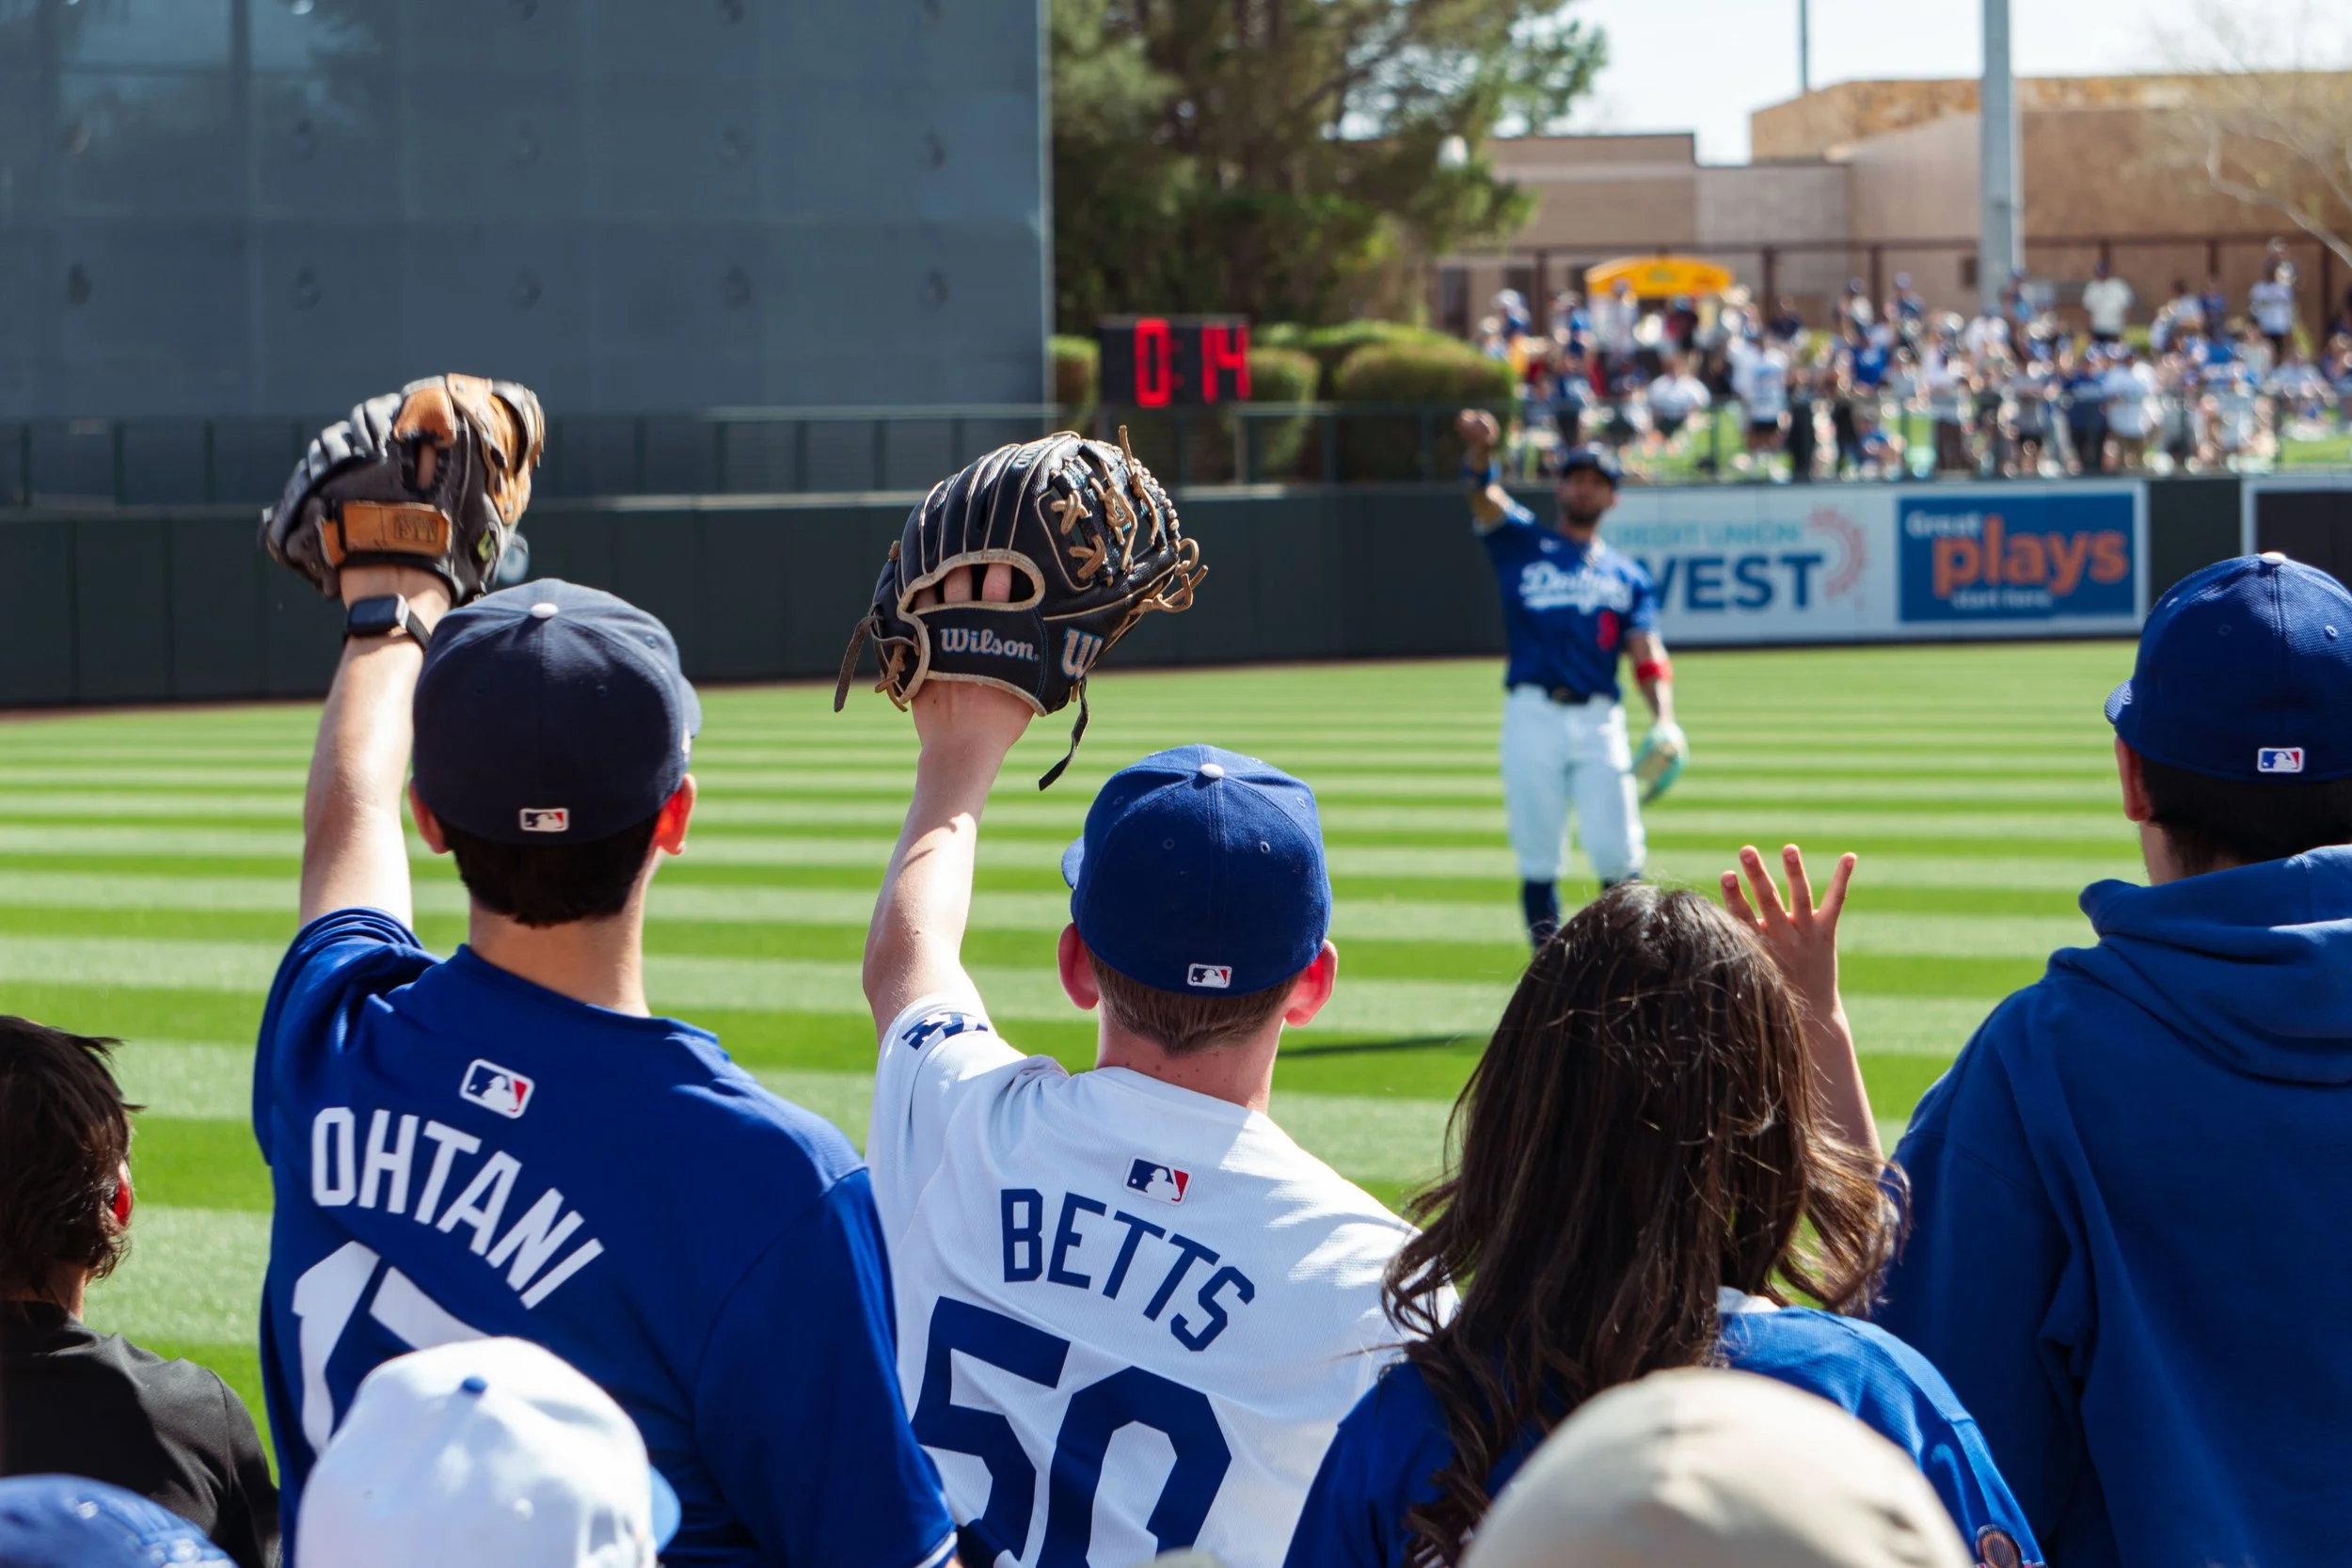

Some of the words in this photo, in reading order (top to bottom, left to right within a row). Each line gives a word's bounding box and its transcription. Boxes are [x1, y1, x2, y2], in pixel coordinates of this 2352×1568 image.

[1704, 523, 1801, 548] UNION
[1905, 510, 1982, 540] Great
[1931, 513, 2129, 598] plays
[941, 627, 1034, 660] Wilson
[1060, 625, 1104, 679] W
[311, 1106, 605, 1310] OHTANI
[1000, 1188, 1256, 1352] BETTS
[911, 1295, 1232, 1568] 50
